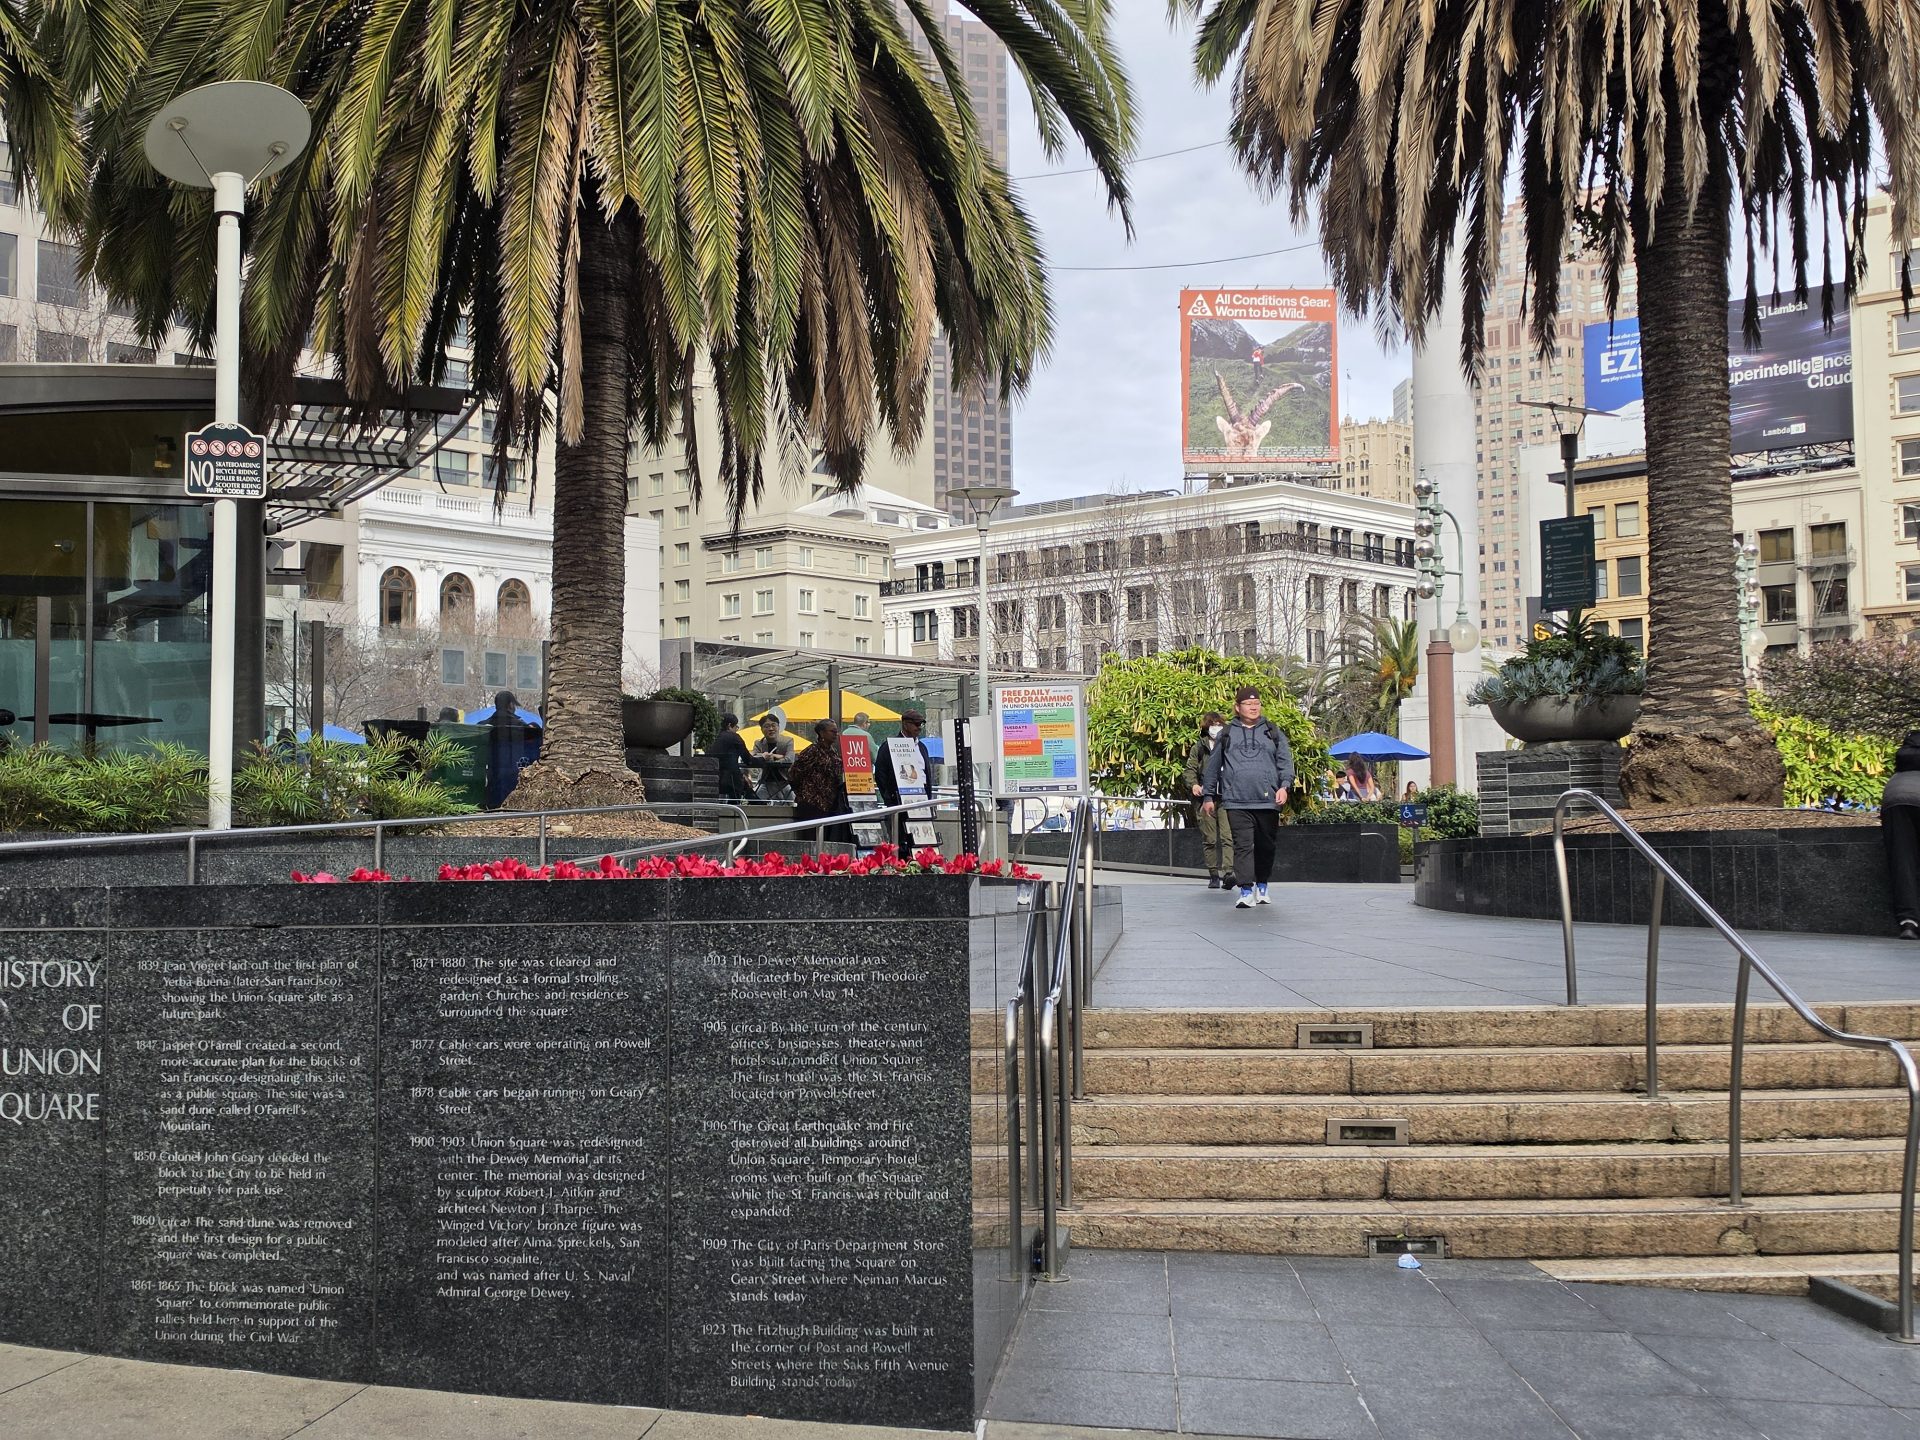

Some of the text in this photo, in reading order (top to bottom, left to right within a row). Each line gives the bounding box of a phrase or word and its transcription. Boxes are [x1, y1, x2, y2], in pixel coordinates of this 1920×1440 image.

[1215, 294, 1331, 308] All Conditions Gear.
[1215, 306, 1307, 319] Worn to be Wild.
[1768, 301, 1808, 316] Lambda
[1600, 347, 1642, 376] EZ
[1807, 369, 1853, 389] Cloud
[190, 460, 215, 487] NO
[1002, 695, 1073, 703] PROGRAMMING
[847, 740, 864, 755] JW
[847, 757, 867, 768] .ORG
[0, 960, 101, 988] ISTORY
[439, 974, 501, 987] redesigned
[533, 974, 570, 983] formal
[575, 974, 619, 987] strolling
[731, 971, 927, 985] dedicated by President Theodore
[161, 992, 206, 1005] showing
[210, 992, 228, 1002] the
[232, 992, 264, 1001] Union
[268, 992, 304, 1005] Square
[308, 992, 327, 1001] site
[62, 1003, 102, 1031] OF
[2, 1048, 101, 1076] UNION
[161, 1073, 180, 1082] San
[239, 1072, 300, 1085] designating
[304, 1072, 323, 1082] this
[327, 1073, 346, 1082] site
[0, 1092, 100, 1126] QUARE
[160, 1105, 307, 1114] sand dune called O'Farrell's
[731, 1137, 910, 1151] destroyed all buildings around
[133, 1151, 331, 1166] 1850 Colonel John Geary deeded the
[158, 1168, 326, 1182] block to the City to be held in
[483, 1171, 503, 1180] The
[508, 1171, 562, 1180] memorial
[593, 1171, 645, 1184] designed
[158, 1186, 213, 1198] perpetuity
[217, 1185, 232, 1194] for
[236, 1185, 260, 1198] park
[437, 1220, 643, 1234] 'Winged Victory' bronze figure was
[436, 1237, 487, 1247] modeled
[491, 1237, 519, 1247] after
[523, 1237, 552, 1247] Alma
[619, 1238, 640, 1247] San
[702, 1239, 944, 1253] 1909 The City of Paris Department Store
[436, 1254, 489, 1264] Francisco
[436, 1270, 457, 1280] and
[489, 1271, 529, 1280] named
[533, 1271, 560, 1280] after
[599, 1271, 631, 1281] Naval
[731, 1274, 947, 1287] Geary Street where Neiman Marcus
[436, 1287, 480, 1296] Admiral
[484, 1287, 527, 1300] George
[155, 1330, 186, 1340] Union
[190, 1331, 224, 1344] during
[228, 1331, 246, 1341] the
[250, 1332, 273, 1341] Civil
[731, 1342, 751, 1352] the
[799, 1343, 811, 1352] of
[816, 1343, 840, 1352] Post
[845, 1343, 868, 1352] and
[873, 1343, 911, 1353] Powell
